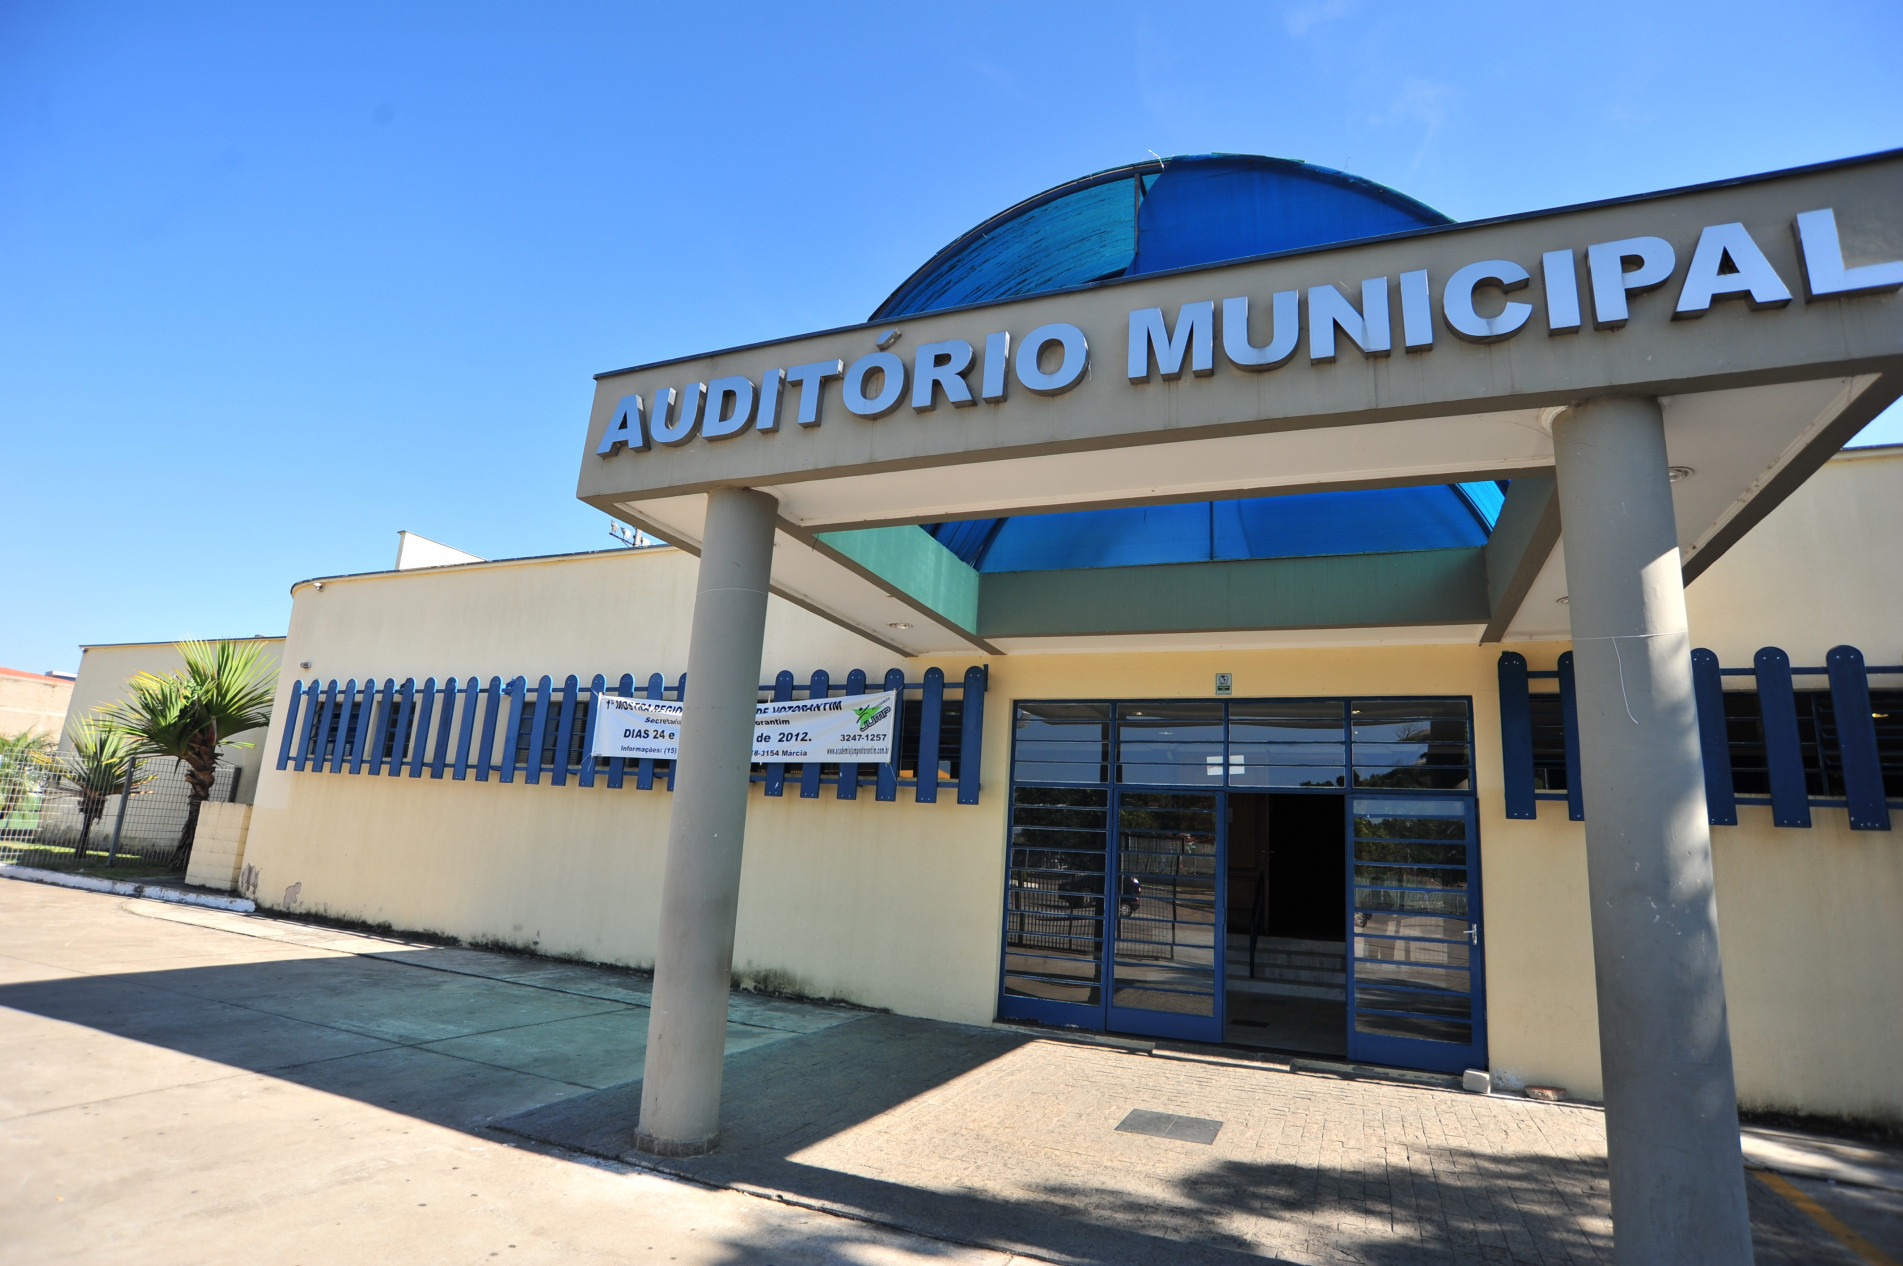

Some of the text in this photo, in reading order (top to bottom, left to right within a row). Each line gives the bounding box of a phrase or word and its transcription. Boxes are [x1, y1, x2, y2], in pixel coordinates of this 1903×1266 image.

[595, 207, 1903, 459] AUDITÓRIO MUNICIPAL
[615, 700, 651, 712] MOSTRA
[651, 703, 683, 714] REGIO
[772, 700, 843, 713] VOTORANTIM
[754, 718, 790, 726] orantim
[623, 728, 812, 743] DIAS 24 e de 2012.
[840, 733, 887, 742] 3247-1257
[620, 745, 808, 757] Informações: (15) 8-3154 Márcia
